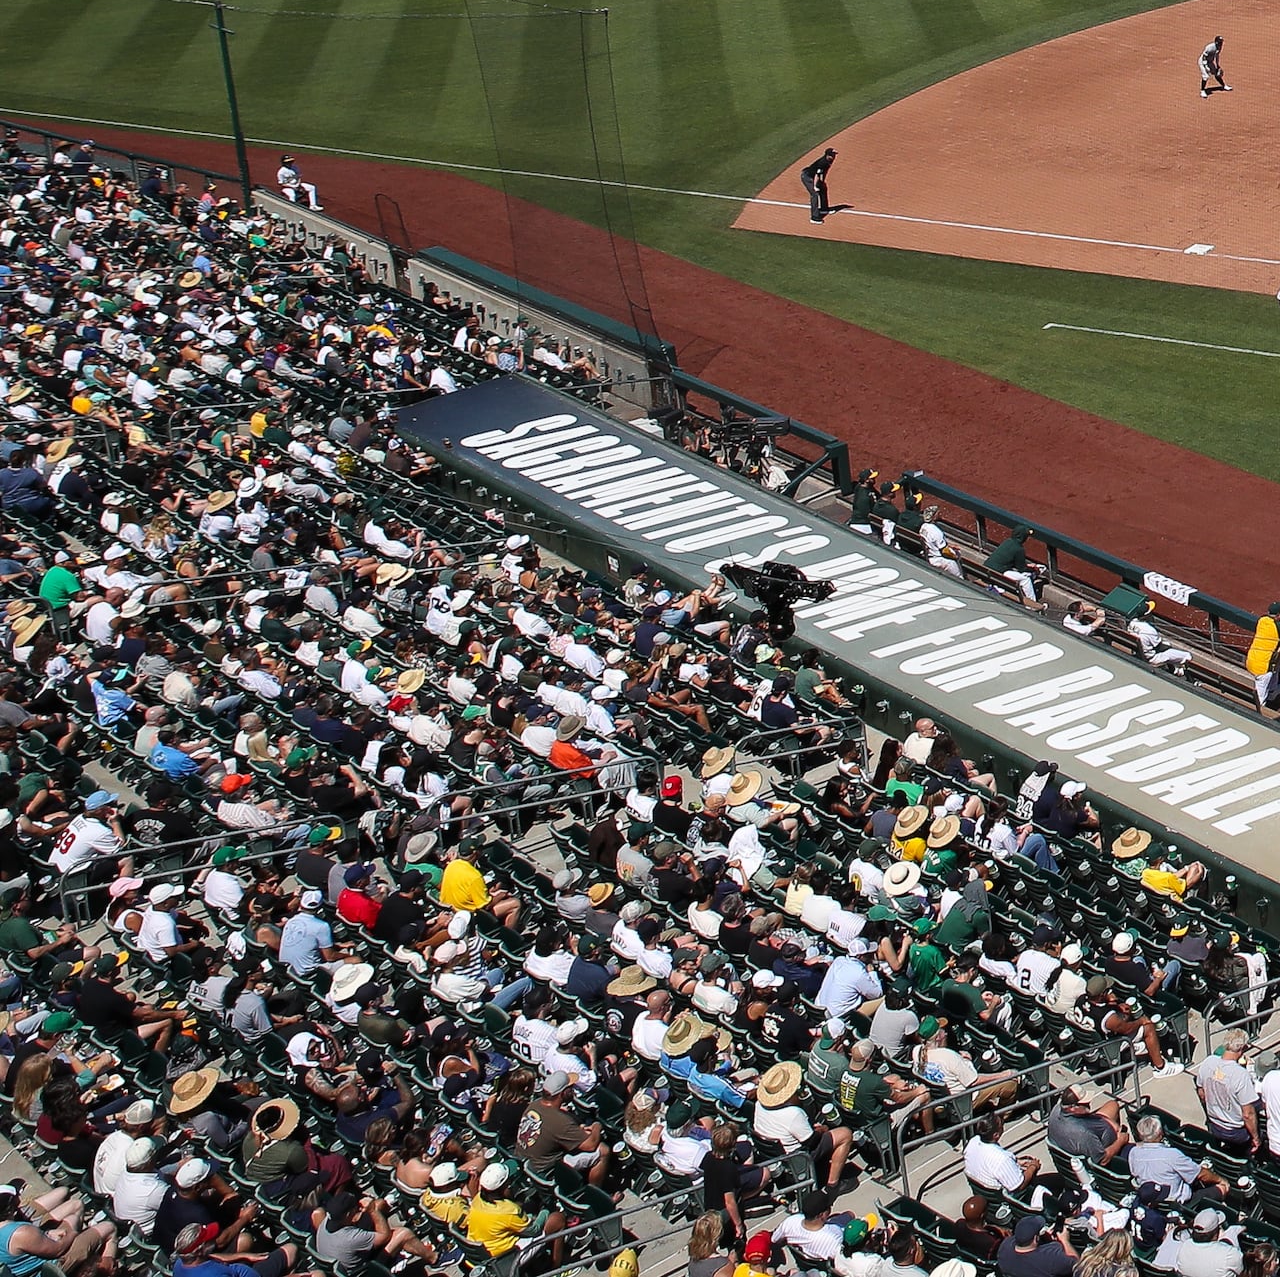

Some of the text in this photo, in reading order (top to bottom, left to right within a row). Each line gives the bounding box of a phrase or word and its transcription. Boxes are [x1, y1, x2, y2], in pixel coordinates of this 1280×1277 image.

[460, 413, 832, 574] SACRAMENTO'S
[869, 616, 1064, 694] FOR
[1021, 968, 1030, 989] 2
